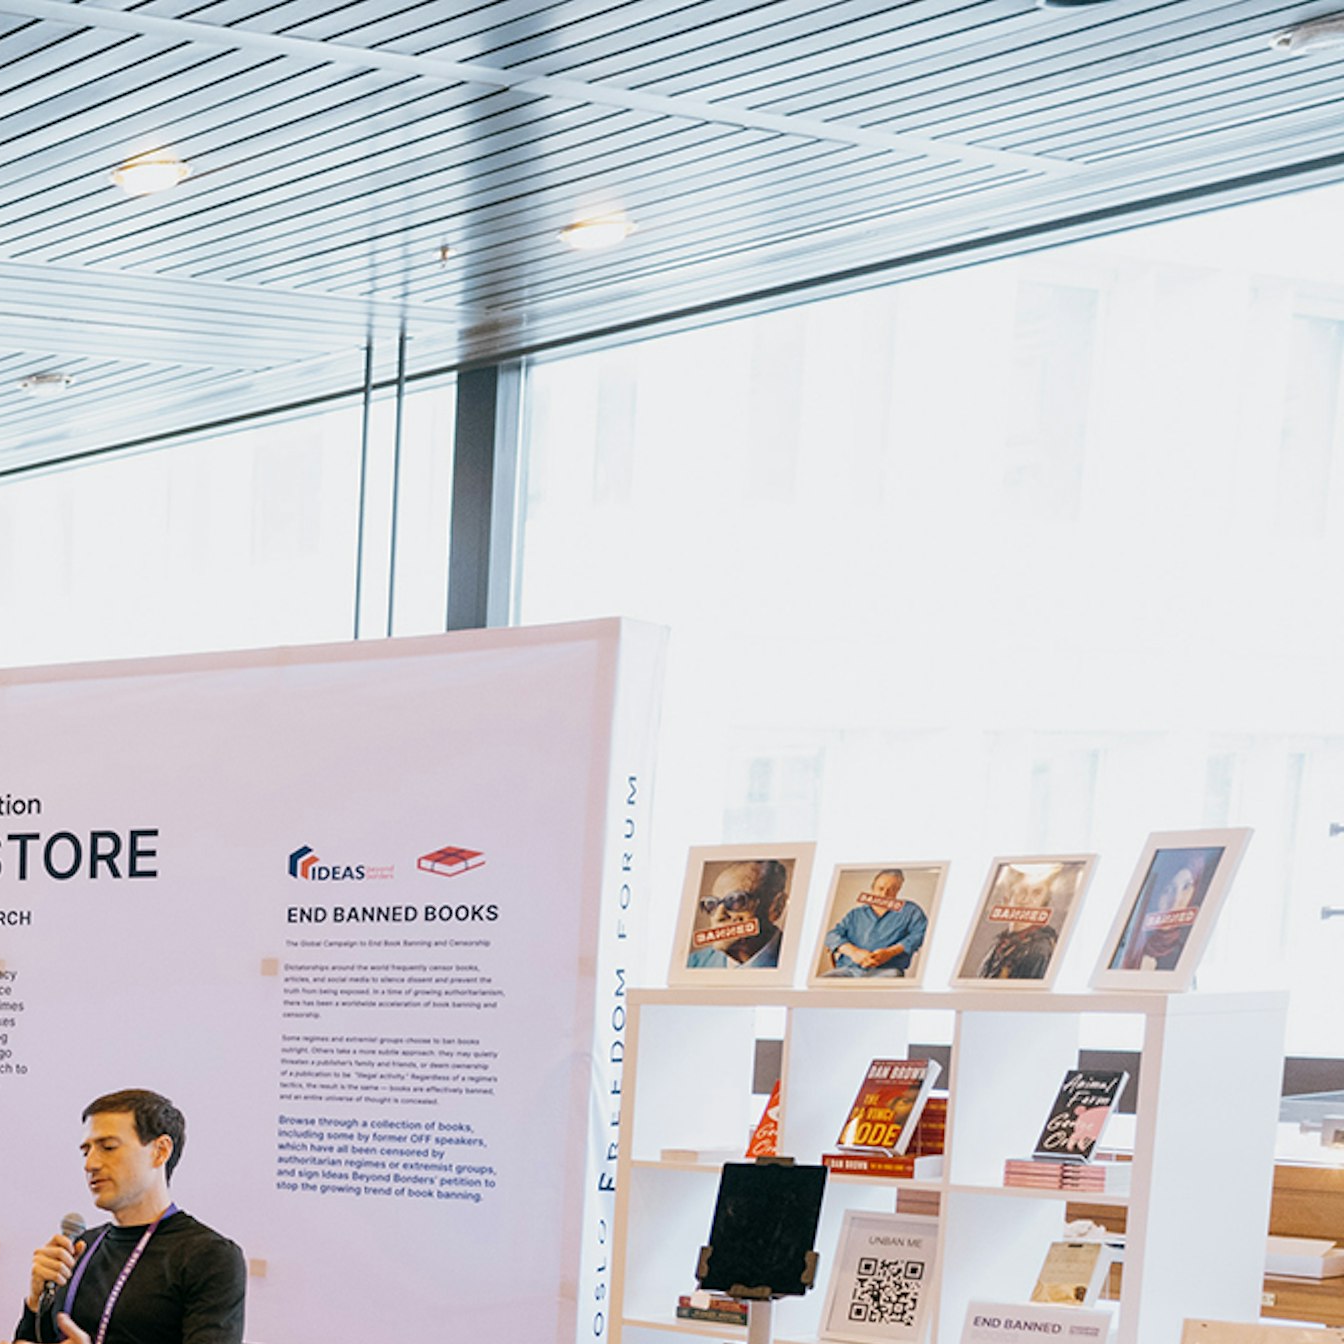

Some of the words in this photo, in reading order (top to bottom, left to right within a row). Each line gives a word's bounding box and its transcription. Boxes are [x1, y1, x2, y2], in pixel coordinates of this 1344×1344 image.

[616, 774, 637, 939] FORUM
[312, 864, 365, 880] IDEAS
[287, 906, 327, 923] END
[333, 906, 418, 922] BANNED
[424, 904, 498, 921] BOOKS
[15, 1063, 28, 1074] to
[868, 1066, 890, 1080] DAN
[890, 1066, 926, 1080] BROWN
[598, 968, 626, 1192] FREEDOM
[1063, 1074, 1118, 1093] Animal
[1067, 1090, 1110, 1107] Farm
[278, 1114, 316, 1126] Browse
[318, 1117, 359, 1130] through
[360, 1120, 368, 1128] a
[370, 1119, 422, 1130] collection
[424, 1120, 435, 1131] of
[437, 1121, 474, 1133] books,
[277, 1128, 324, 1141] including
[326, 1131, 354, 1141] some
[356, 1131, 370, 1143] by
[372, 1132, 407, 1143] former
[410, 1133, 431, 1144] OFF
[434, 1135, 487, 1147] speakers,
[277, 1141, 308, 1152] which
[309, 1143, 334, 1153] have
[336, 1144, 348, 1154] all
[350, 1144, 377, 1155] been
[379, 1146, 429, 1158] censored
[431, 1148, 445, 1160] by
[277, 1154, 342, 1166] authoritarian
[344, 1158, 386, 1170] regimes
[388, 1161, 400, 1169] or
[402, 1161, 453, 1172] extremist
[455, 1164, 496, 1176] groups,
[276, 1167, 296, 1177] and
[297, 1168, 320, 1180] sign
[321, 1169, 349, 1180] Ideas
[351, 1170, 390, 1184] Beyond
[392, 1172, 437, 1185] Borders'
[439, 1176, 482, 1188] petition
[484, 1178, 496, 1188] to
[276, 1180, 298, 1192] stop
[300, 1182, 317, 1191] the
[319, 1183, 362, 1196] growing
[363, 1185, 392, 1196] trend
[394, 1186, 405, 1196] of
[407, 1188, 434, 1198] book
[436, 1189, 484, 1203] banning.
[868, 1236, 904, 1246] UNBAN
[907, 1238, 922, 1248] ME
[973, 1316, 1001, 1328] END
[1003, 1319, 1062, 1334] BANNED
